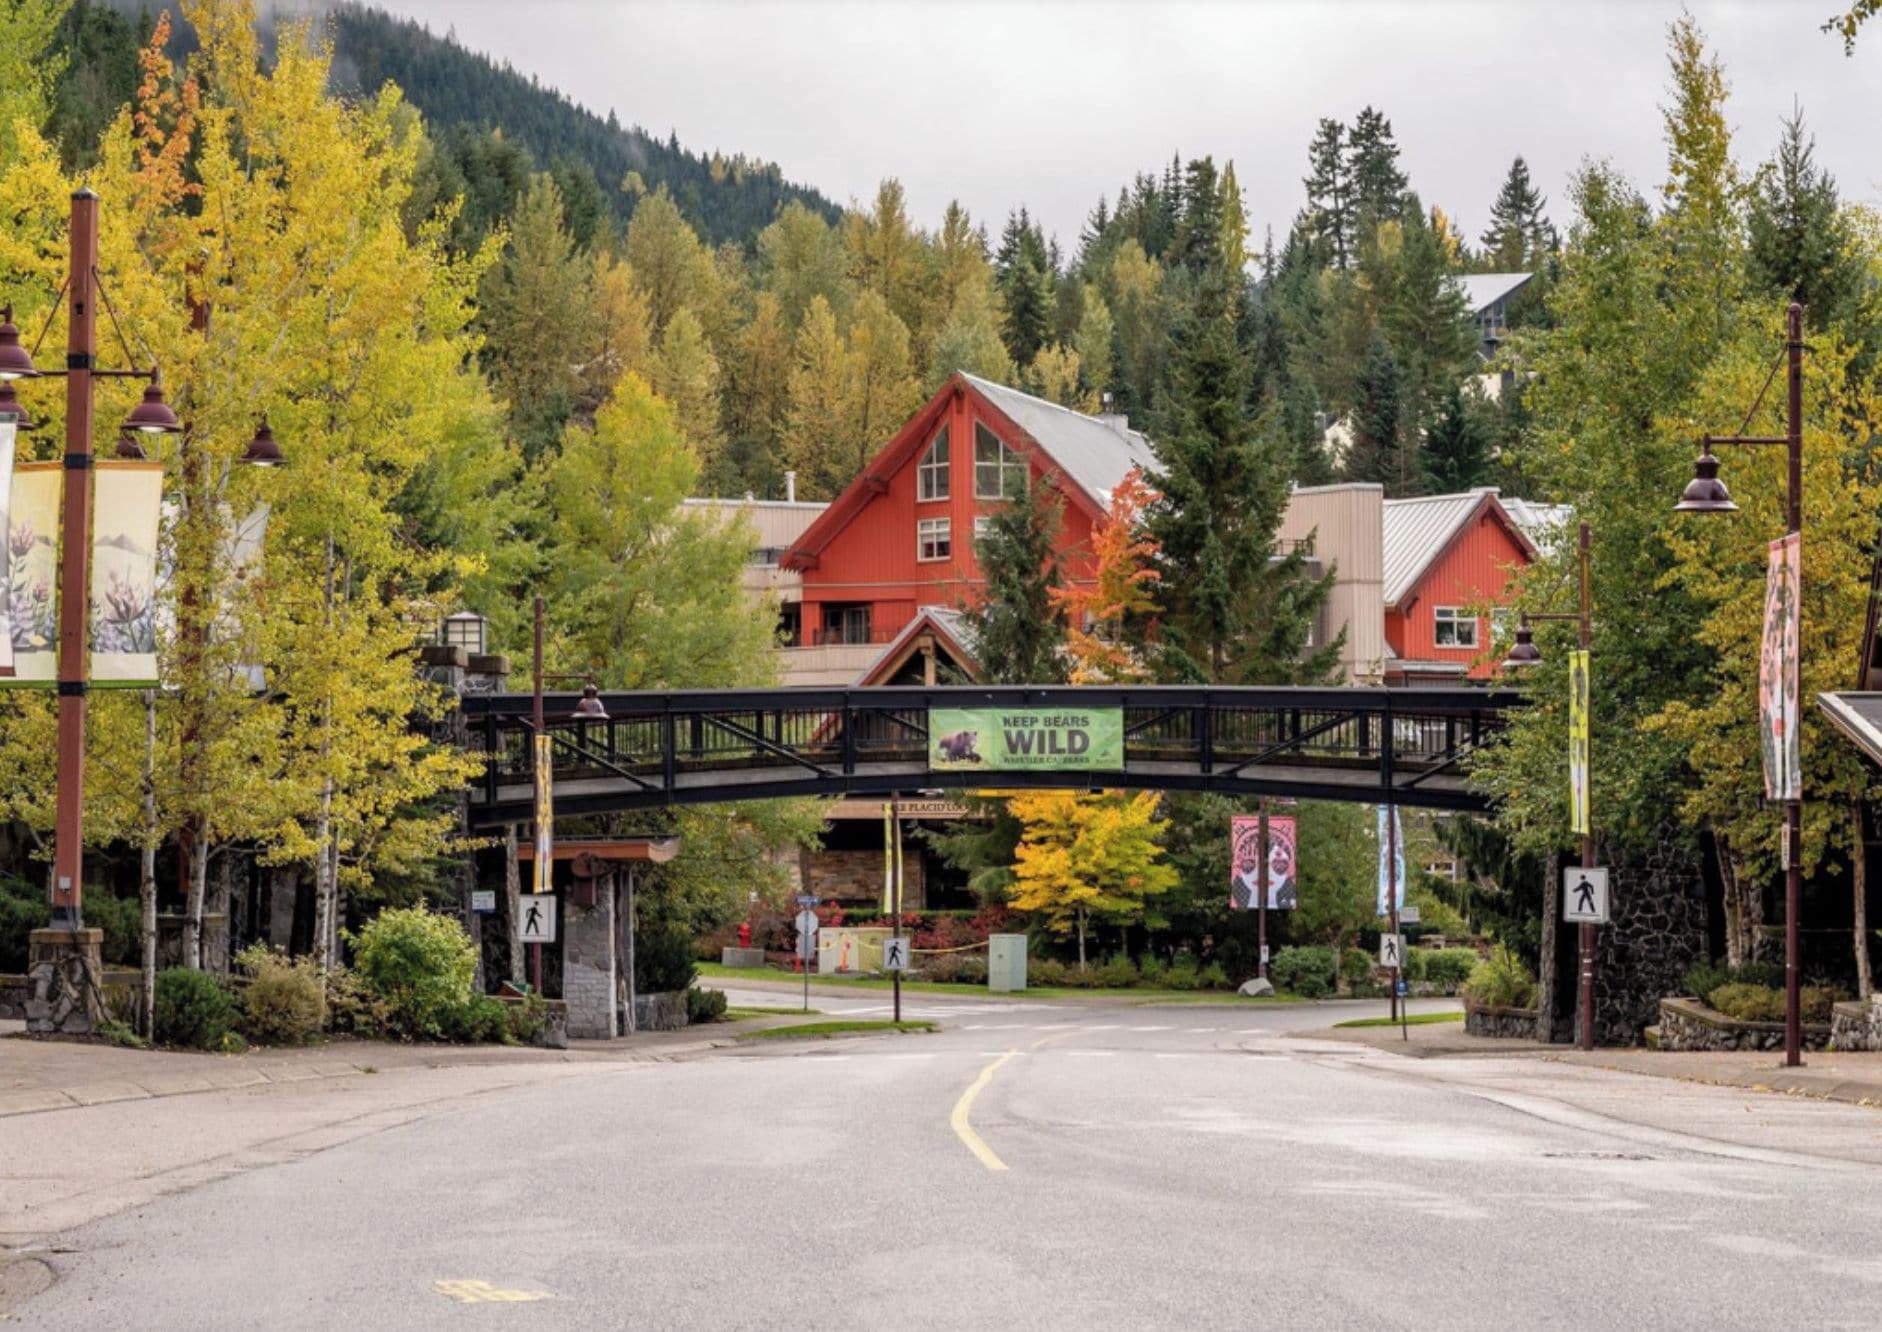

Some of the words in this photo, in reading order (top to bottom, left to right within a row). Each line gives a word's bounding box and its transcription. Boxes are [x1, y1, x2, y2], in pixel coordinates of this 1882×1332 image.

[1003, 716, 1038, 727] KEEP
[1044, 716, 1090, 727] BEARS
[1004, 729, 1090, 755] WILD
